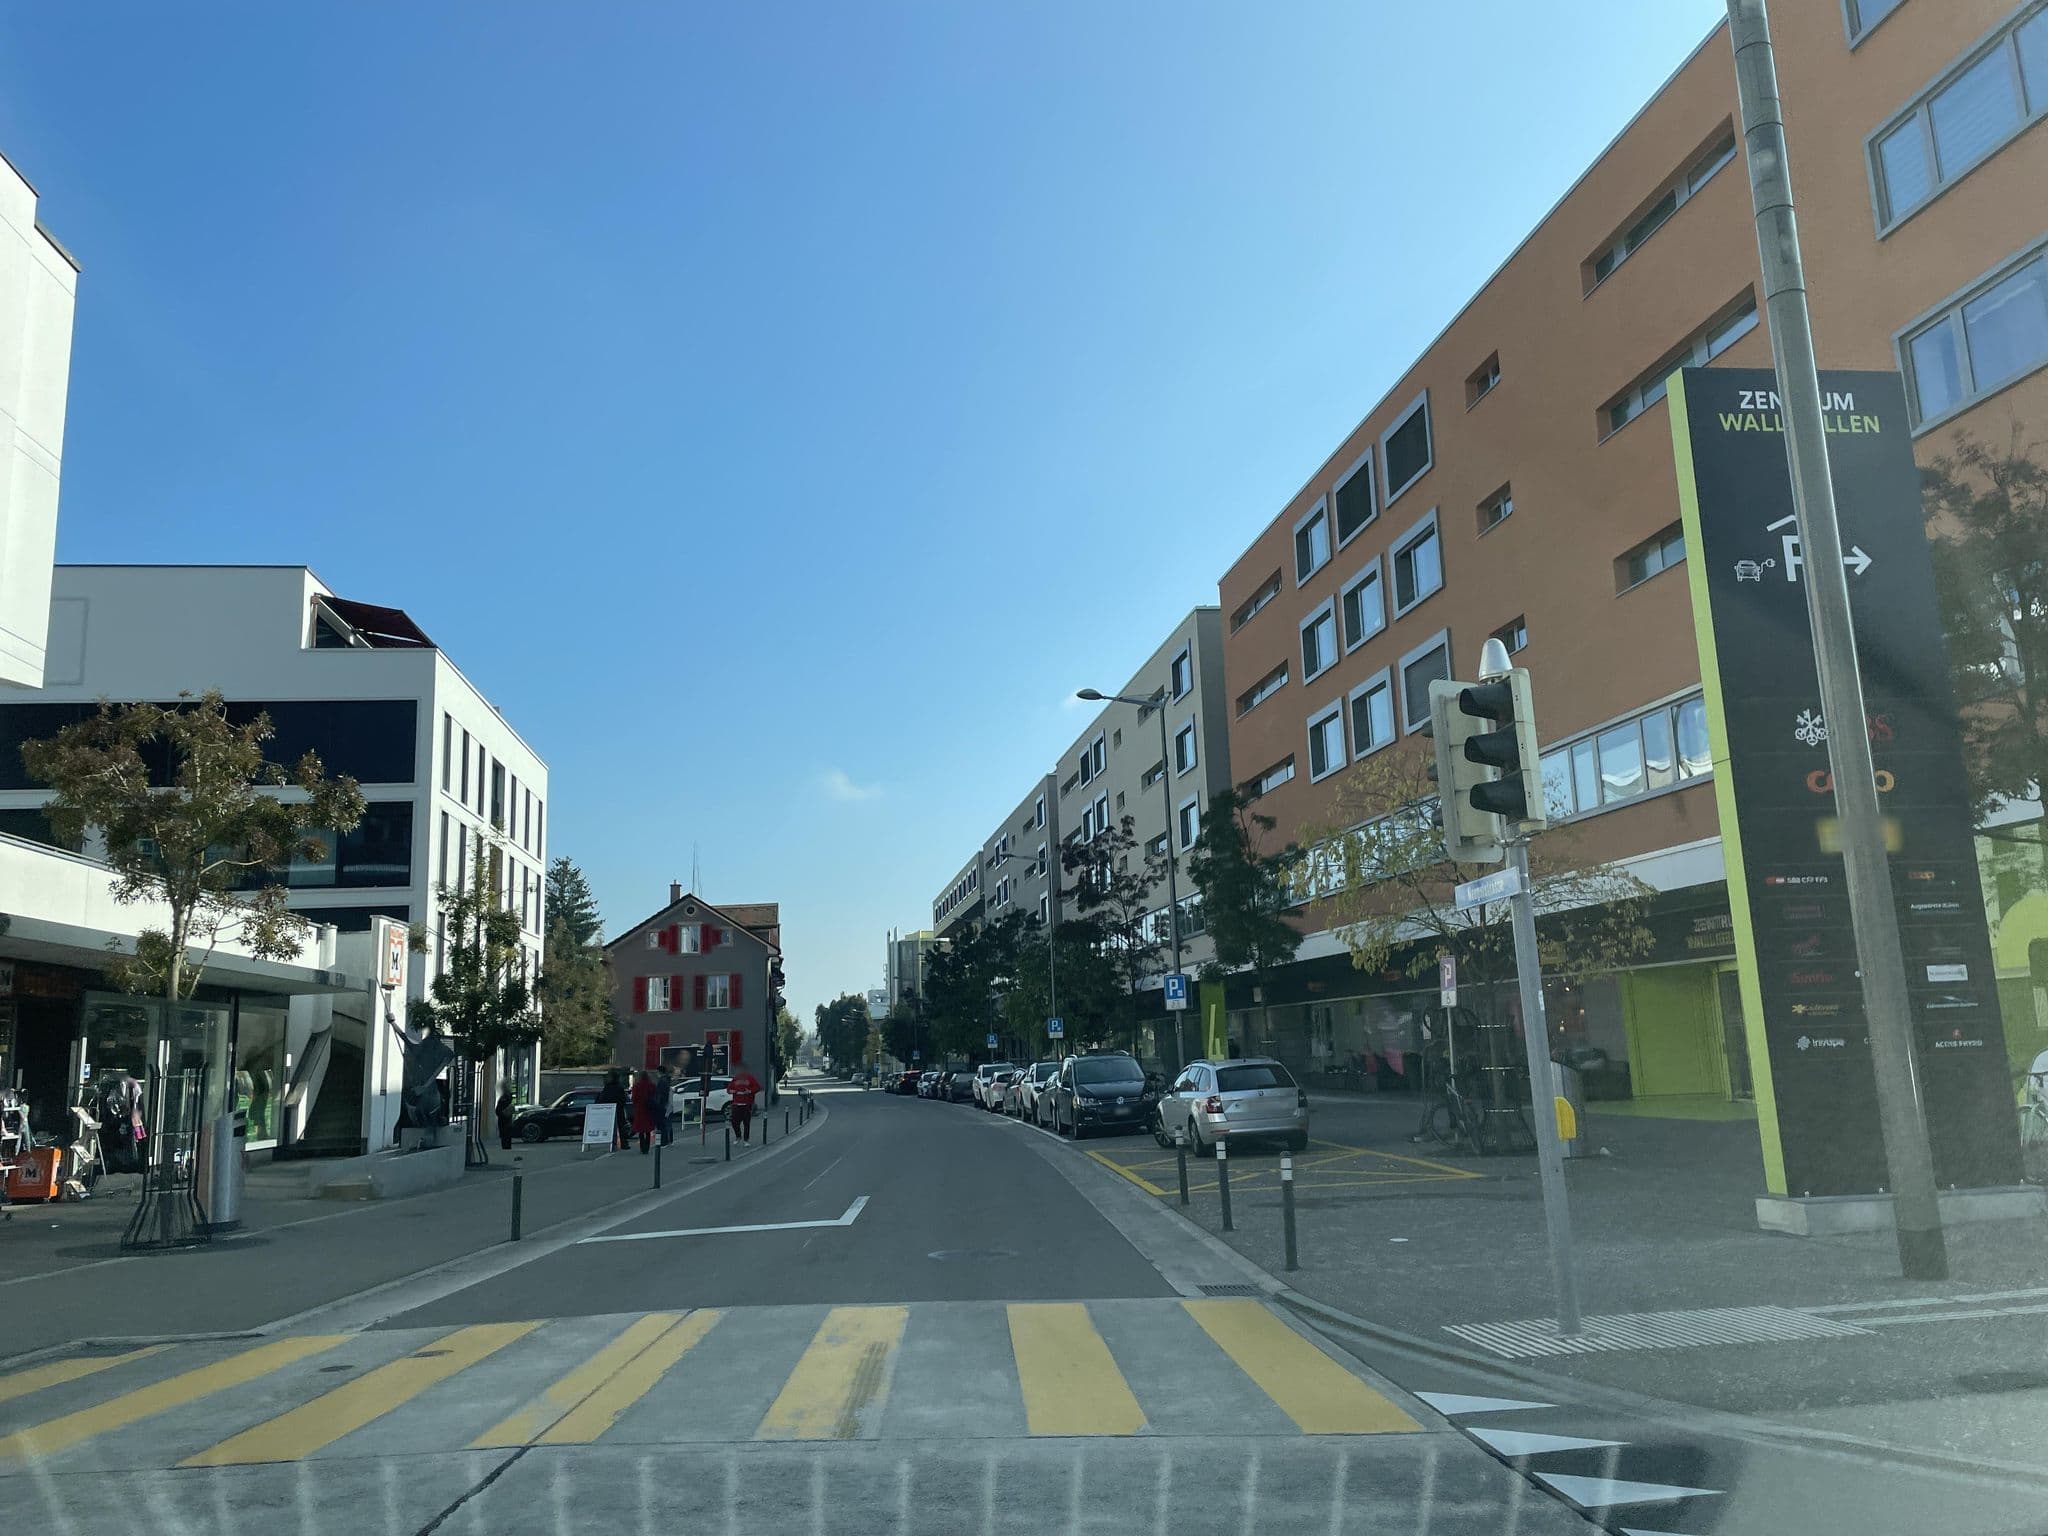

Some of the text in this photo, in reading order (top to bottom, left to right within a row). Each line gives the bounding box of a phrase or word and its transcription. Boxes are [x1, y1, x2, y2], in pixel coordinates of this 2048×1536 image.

[1736, 390, 1854, 411] ZENUM
[1716, 412, 1880, 433] WALLLLEN
[1168, 978, 1179, 997] P
[1051, 1020, 1059, 1031] P
